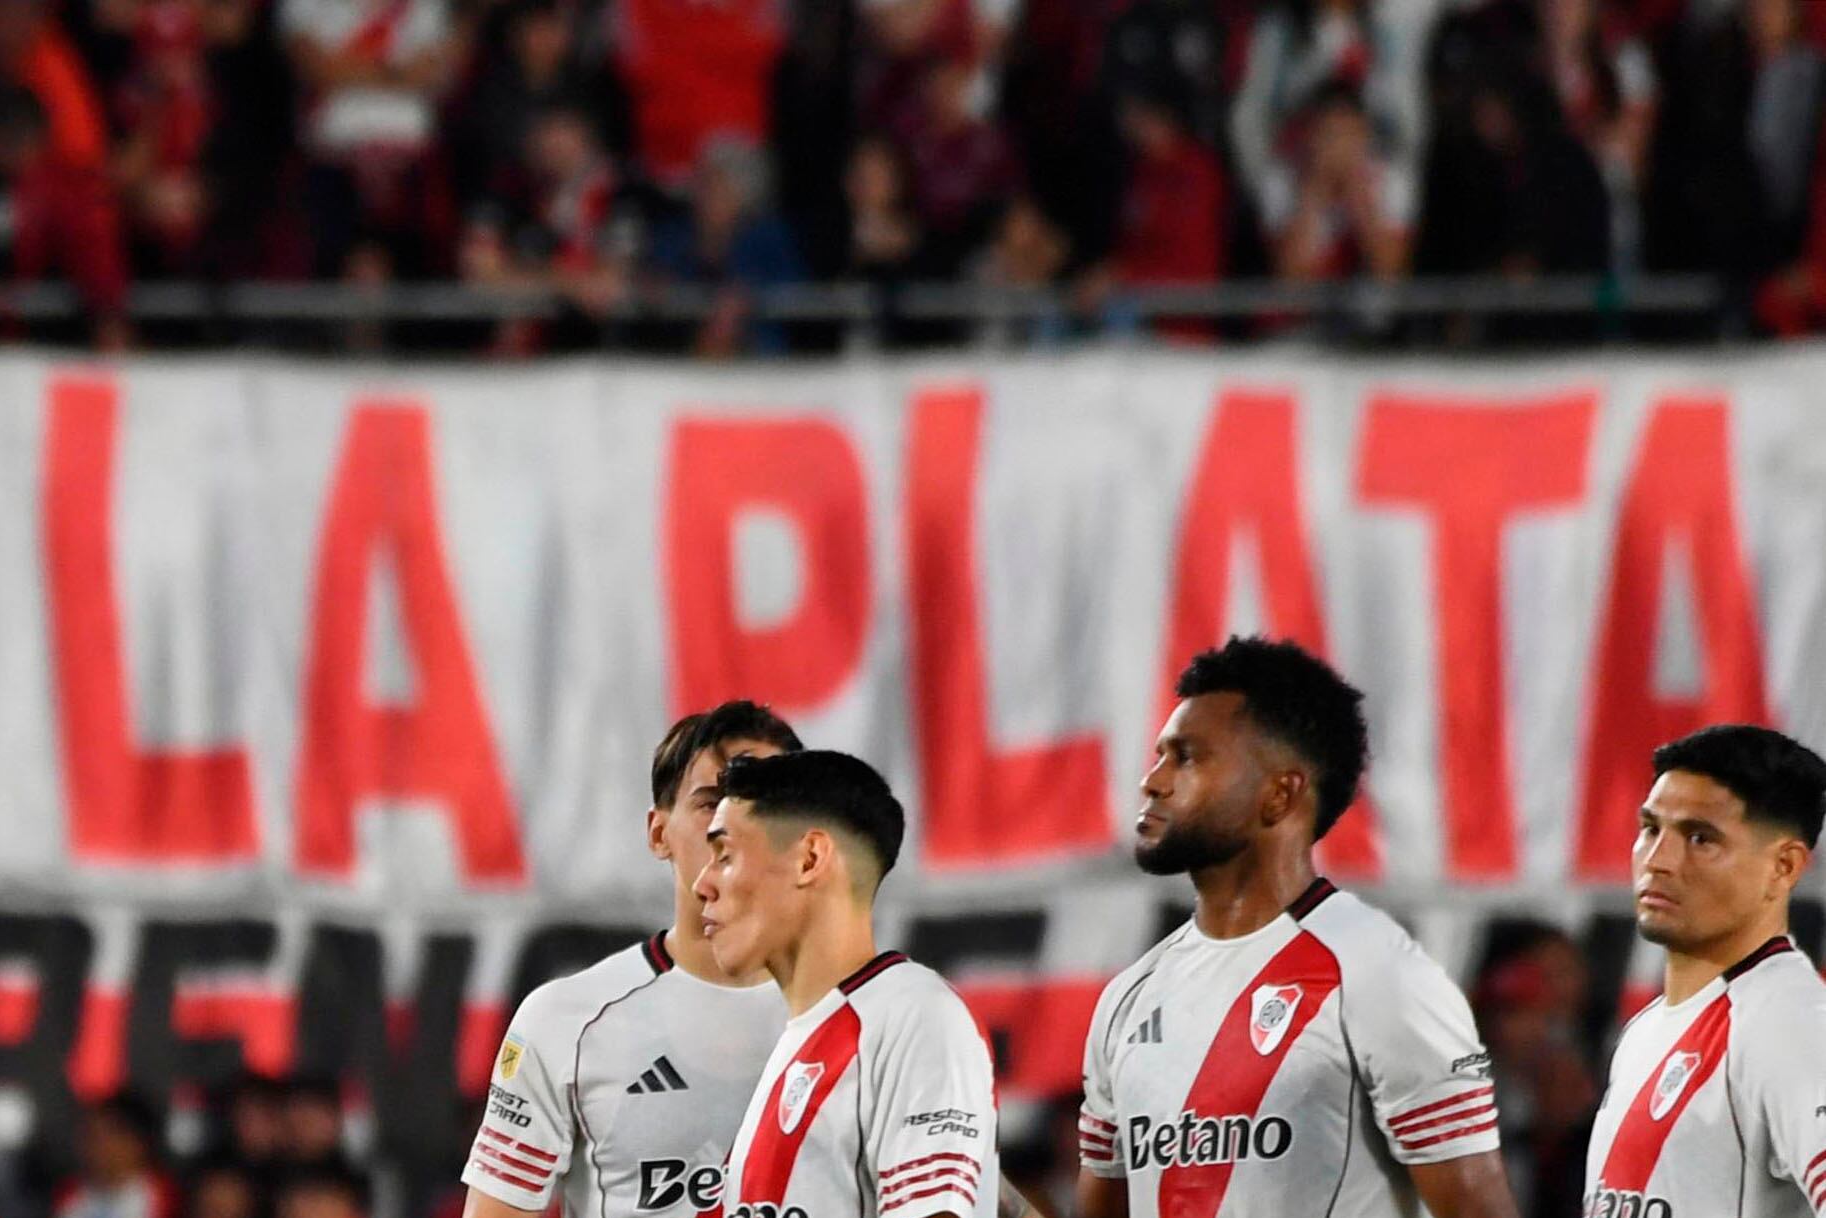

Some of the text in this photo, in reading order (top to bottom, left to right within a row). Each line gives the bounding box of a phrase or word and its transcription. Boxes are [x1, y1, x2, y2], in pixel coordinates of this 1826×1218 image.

[41, 375, 1786, 892] LA PLATA
[1128, 1112, 1293, 1170] Betano
